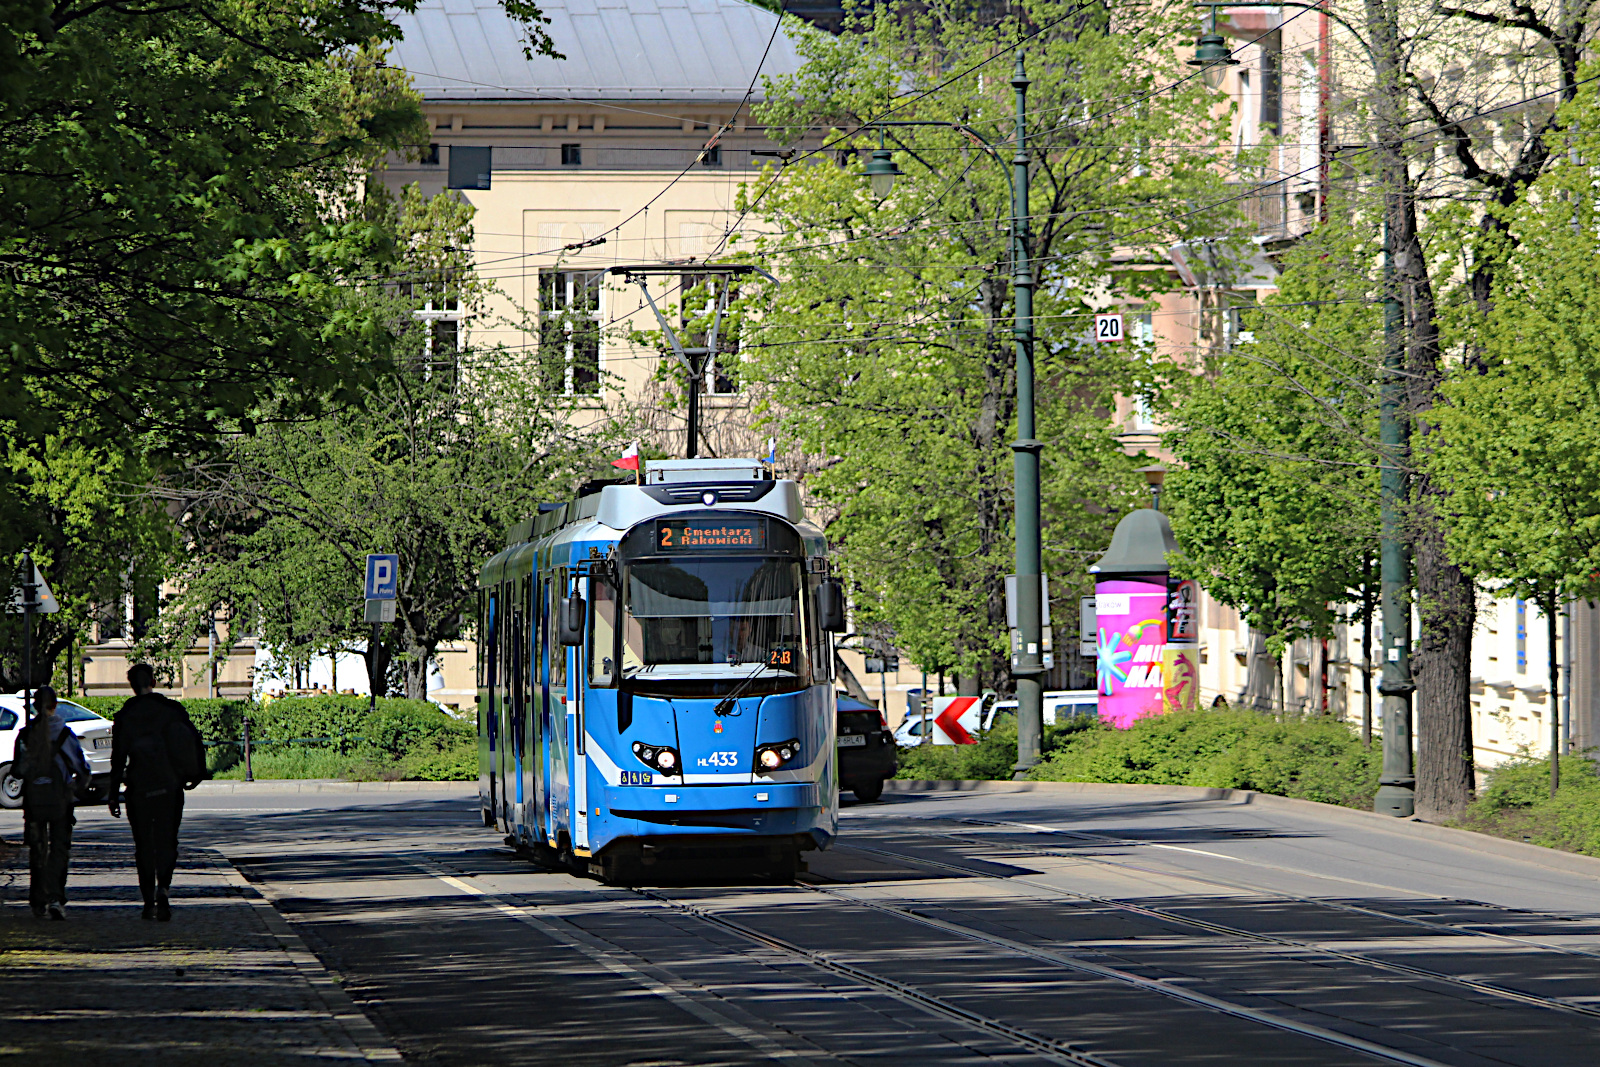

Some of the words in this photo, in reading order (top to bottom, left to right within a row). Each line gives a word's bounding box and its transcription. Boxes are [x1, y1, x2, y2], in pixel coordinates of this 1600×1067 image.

[1100, 318, 1119, 337] 20
[661, 527, 673, 546] 2
[681, 536, 753, 545] Rakowicki
[684, 527, 751, 536] Cmentarz
[373, 560, 391, 594] P
[1123, 665, 1165, 688] MA
